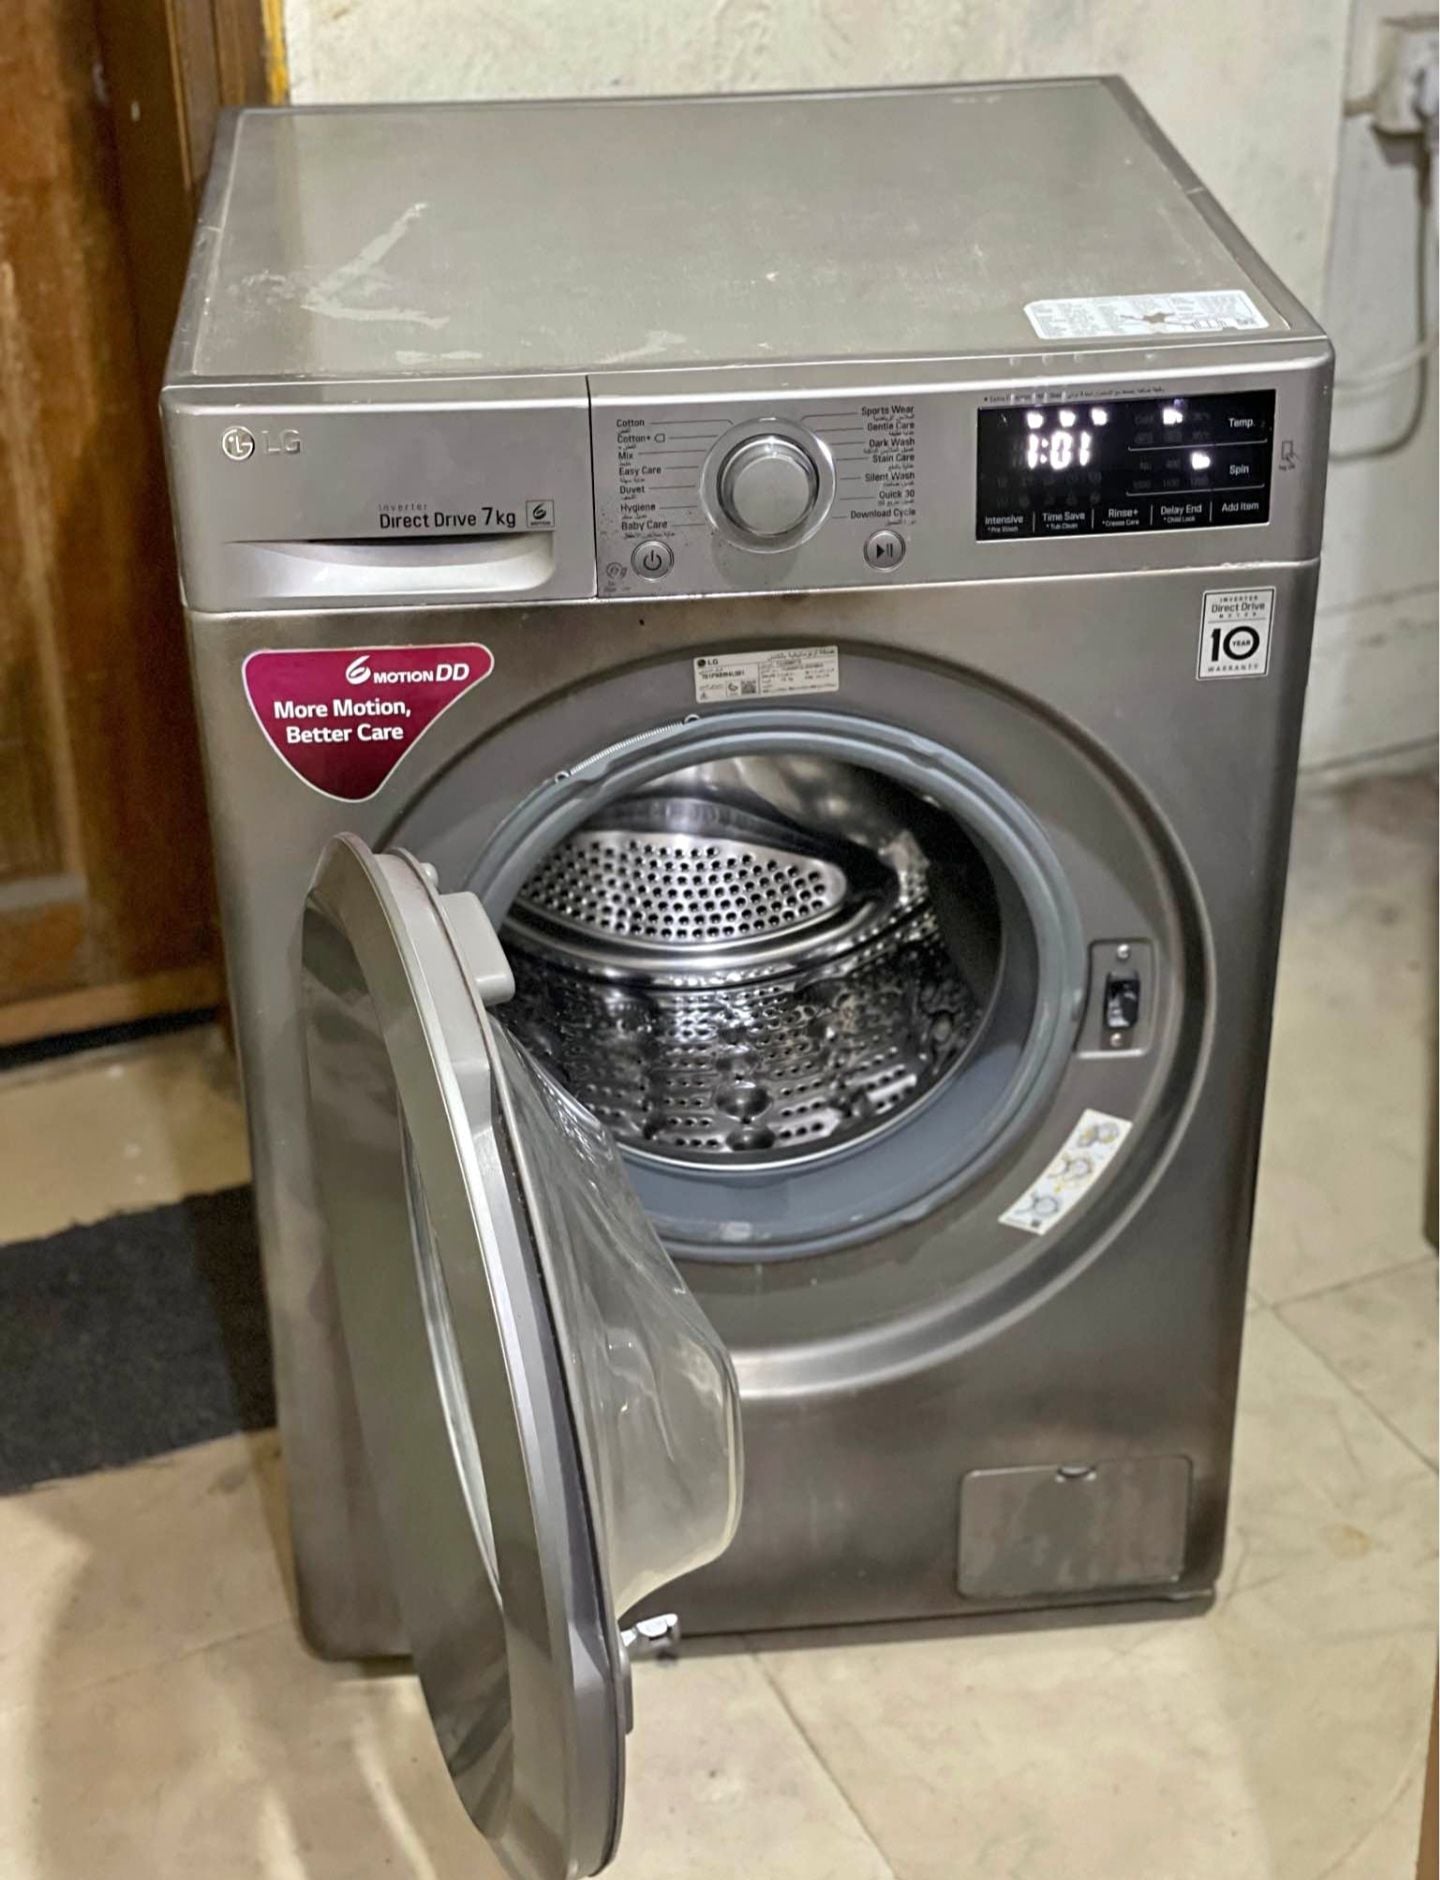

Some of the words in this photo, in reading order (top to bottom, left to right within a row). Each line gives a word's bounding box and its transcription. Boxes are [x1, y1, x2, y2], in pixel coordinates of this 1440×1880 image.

[862, 406, 889, 417] Sports
[891, 405, 914, 414] Wear
[616, 419, 645, 428] Cotton
[1228, 418, 1255, 428] Temp.
[261, 429, 301, 454] LG
[869, 438, 888, 448] Dark
[618, 452, 633, 460] Mix
[872, 454, 894, 463] Stain
[895, 453, 915, 461] Care
[619, 467, 639, 477] Easy
[641, 466, 662, 474] Care
[1229, 464, 1250, 475] Spin
[619, 485, 645, 494] Duvet
[879, 490, 902, 499] Quick
[620, 503, 656, 513] Hygiene
[1160, 506, 1184, 516] Delay
[1186, 504, 1203, 514] End
[1221, 502, 1239, 512] Add
[850, 509, 891, 519] Download
[985, 513, 1024, 525] Intensive
[1042, 513, 1062, 522] Time
[1064, 511, 1085, 521] Save
[379, 513, 430, 529] Direct
[434, 511, 477, 527] Drive
[621, 521, 645, 531] Baby
[646, 519, 668, 529] Care
[1211, 603, 1239, 613] Direct
[1241, 602, 1266, 611] Drive
[1211, 625, 1261, 662] 10
[1232, 639, 1251, 647] YEAR
[273, 700, 328, 719] More
[332, 698, 412, 718] Motion,
[286, 725, 352, 744] Better
[357, 723, 404, 741] Care
